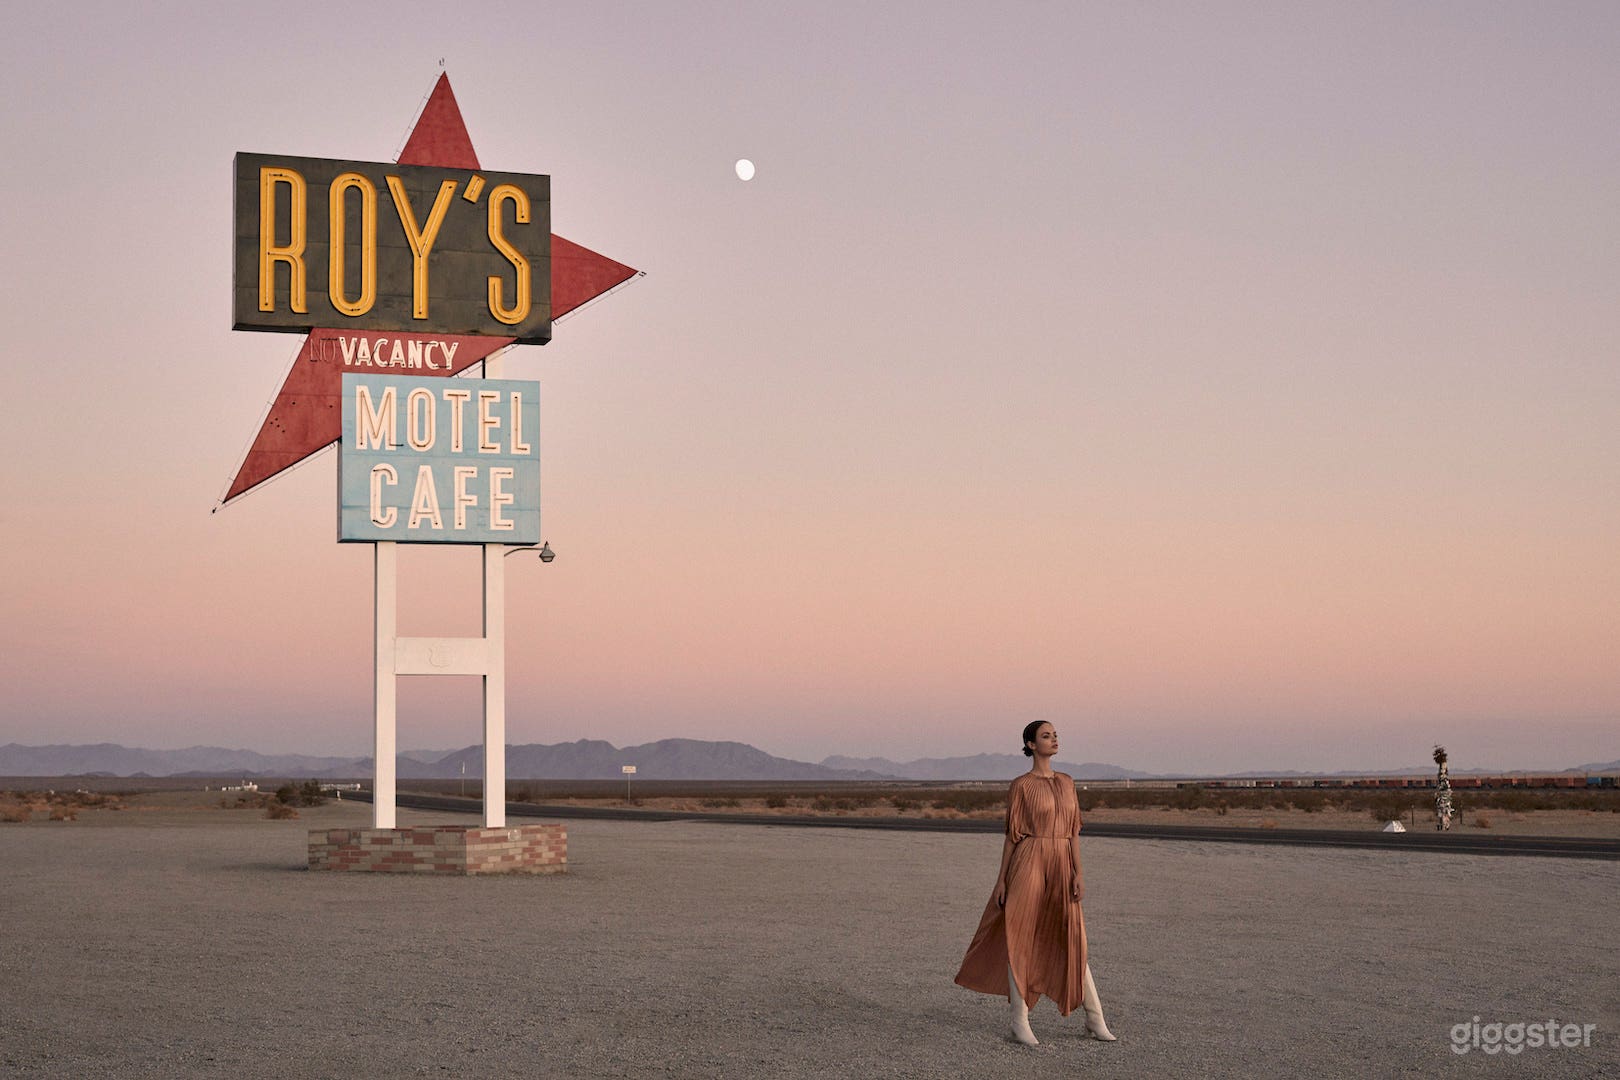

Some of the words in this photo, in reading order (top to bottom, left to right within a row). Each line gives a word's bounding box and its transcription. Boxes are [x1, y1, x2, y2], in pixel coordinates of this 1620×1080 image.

[259, 167, 531, 324] ROY'S
[339, 337, 459, 370] VACANCY
[355, 385, 531, 455] MOTEL
[370, 463, 514, 530] CAFE
